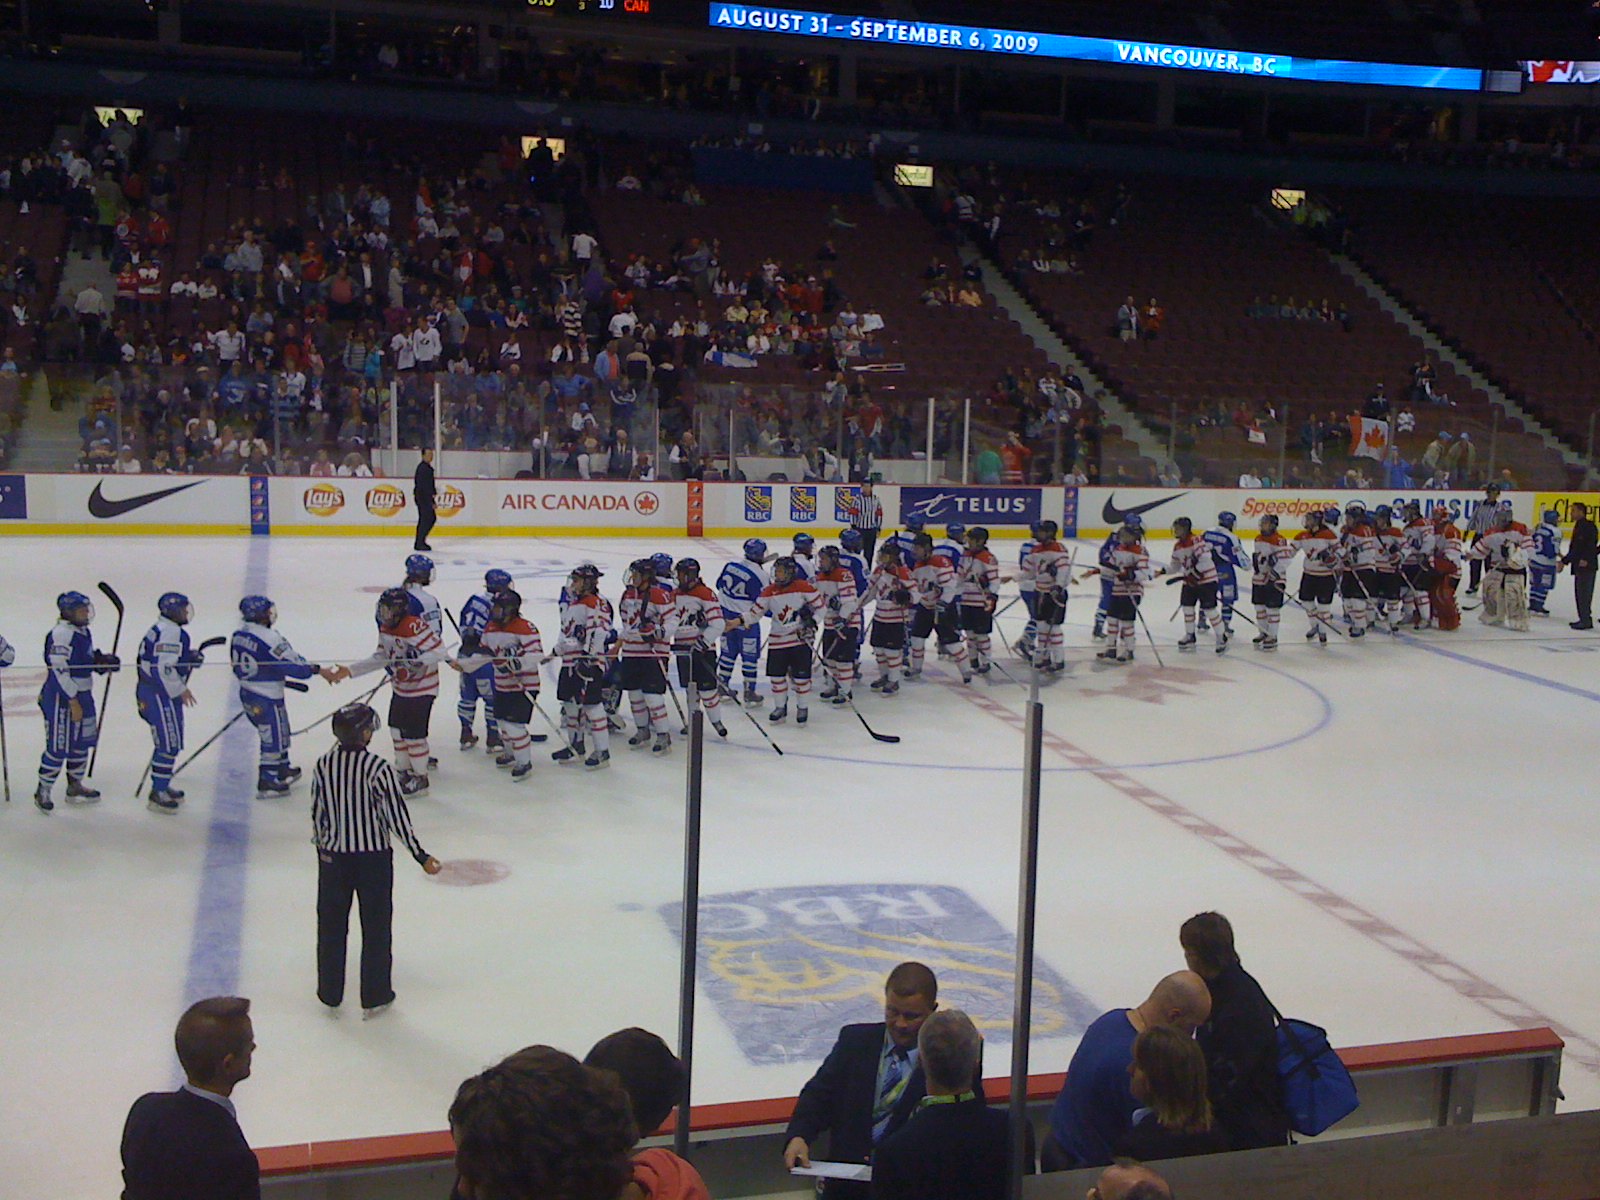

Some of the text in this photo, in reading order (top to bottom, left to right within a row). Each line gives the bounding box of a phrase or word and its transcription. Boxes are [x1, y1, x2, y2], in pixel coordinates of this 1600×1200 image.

[623, 0, 650, 13] CAN
[718, 8, 803, 31] AUGUST
[810, 17, 828, 33] 31
[850, 20, 962, 46] SEPTEMBER
[969, 31, 985, 50] 6,
[992, 33, 1038, 52] 2009
[1117, 43, 1277, 74] VANCOUVER, BC
[501, 494, 630, 511] AIR CANADA
[954, 497, 1026, 513] TELUS
[746, 511, 770, 521] RBC
[791, 511, 815, 521] RBC
[409, 618, 428, 635] 22
